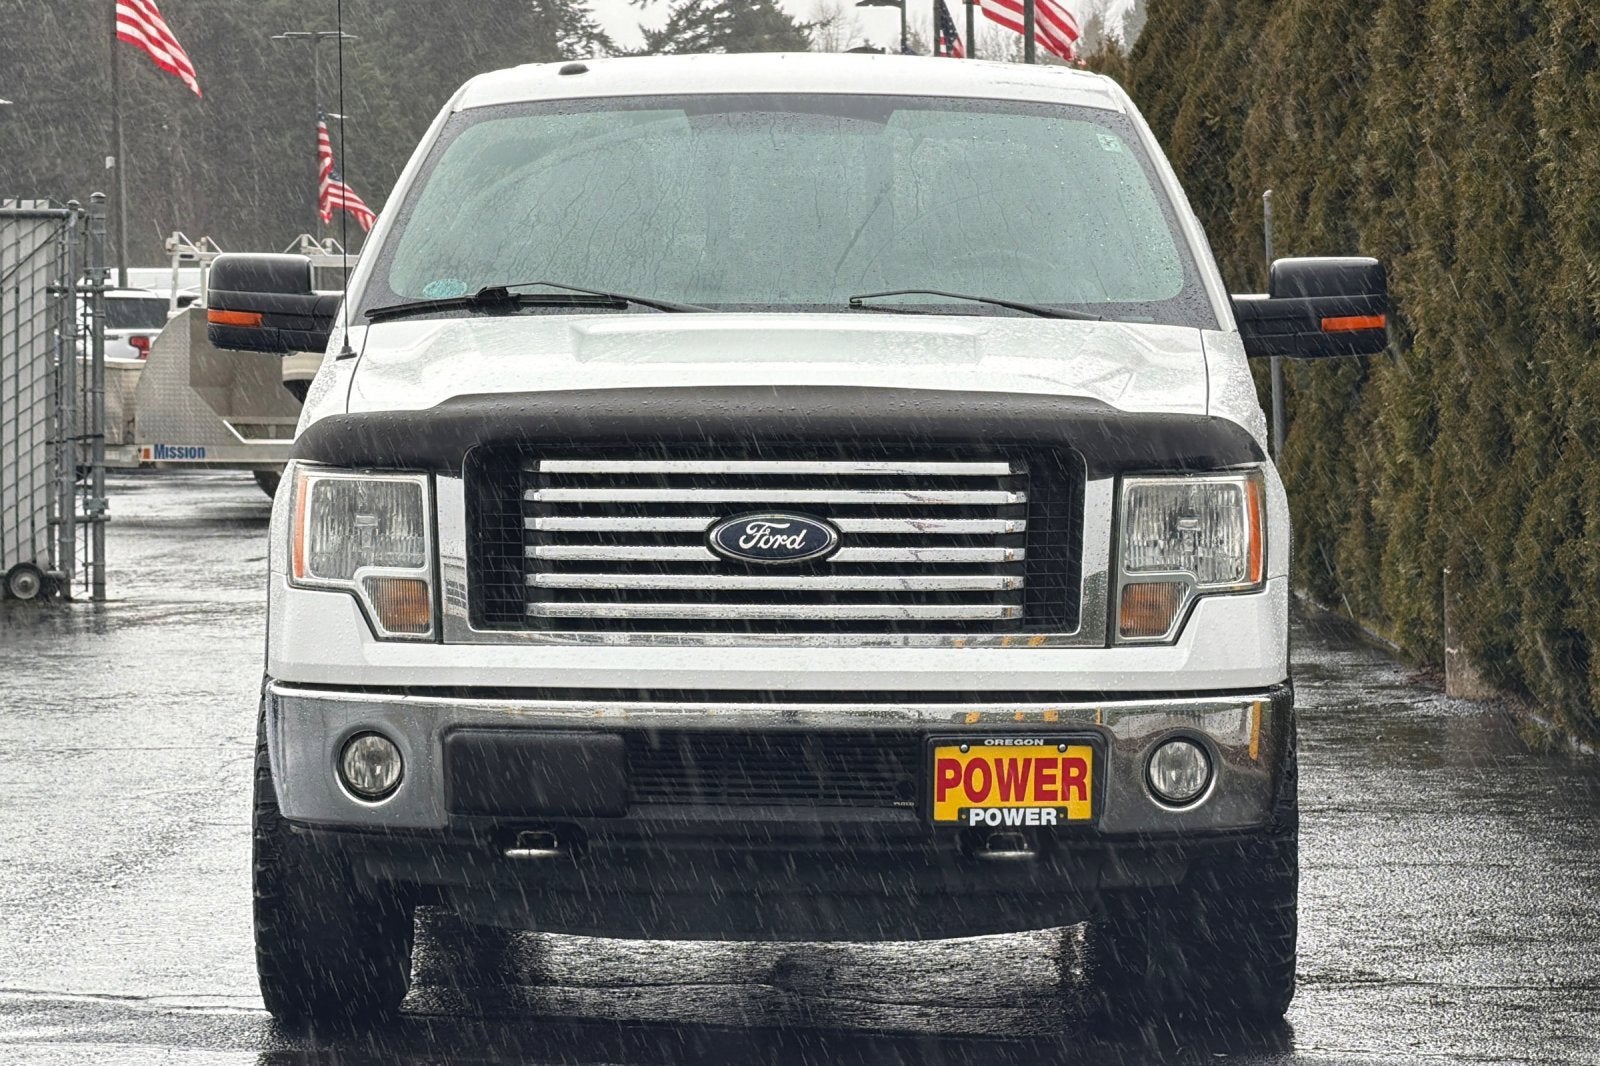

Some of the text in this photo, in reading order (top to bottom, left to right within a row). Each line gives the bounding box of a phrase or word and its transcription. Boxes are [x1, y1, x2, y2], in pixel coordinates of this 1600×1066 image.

[153, 444, 205, 459] Mission
[739, 521, 807, 549] Ford
[984, 738, 1044, 746] OREGON
[936, 757, 1088, 803] POWER
[969, 807, 1057, 826] POWER
